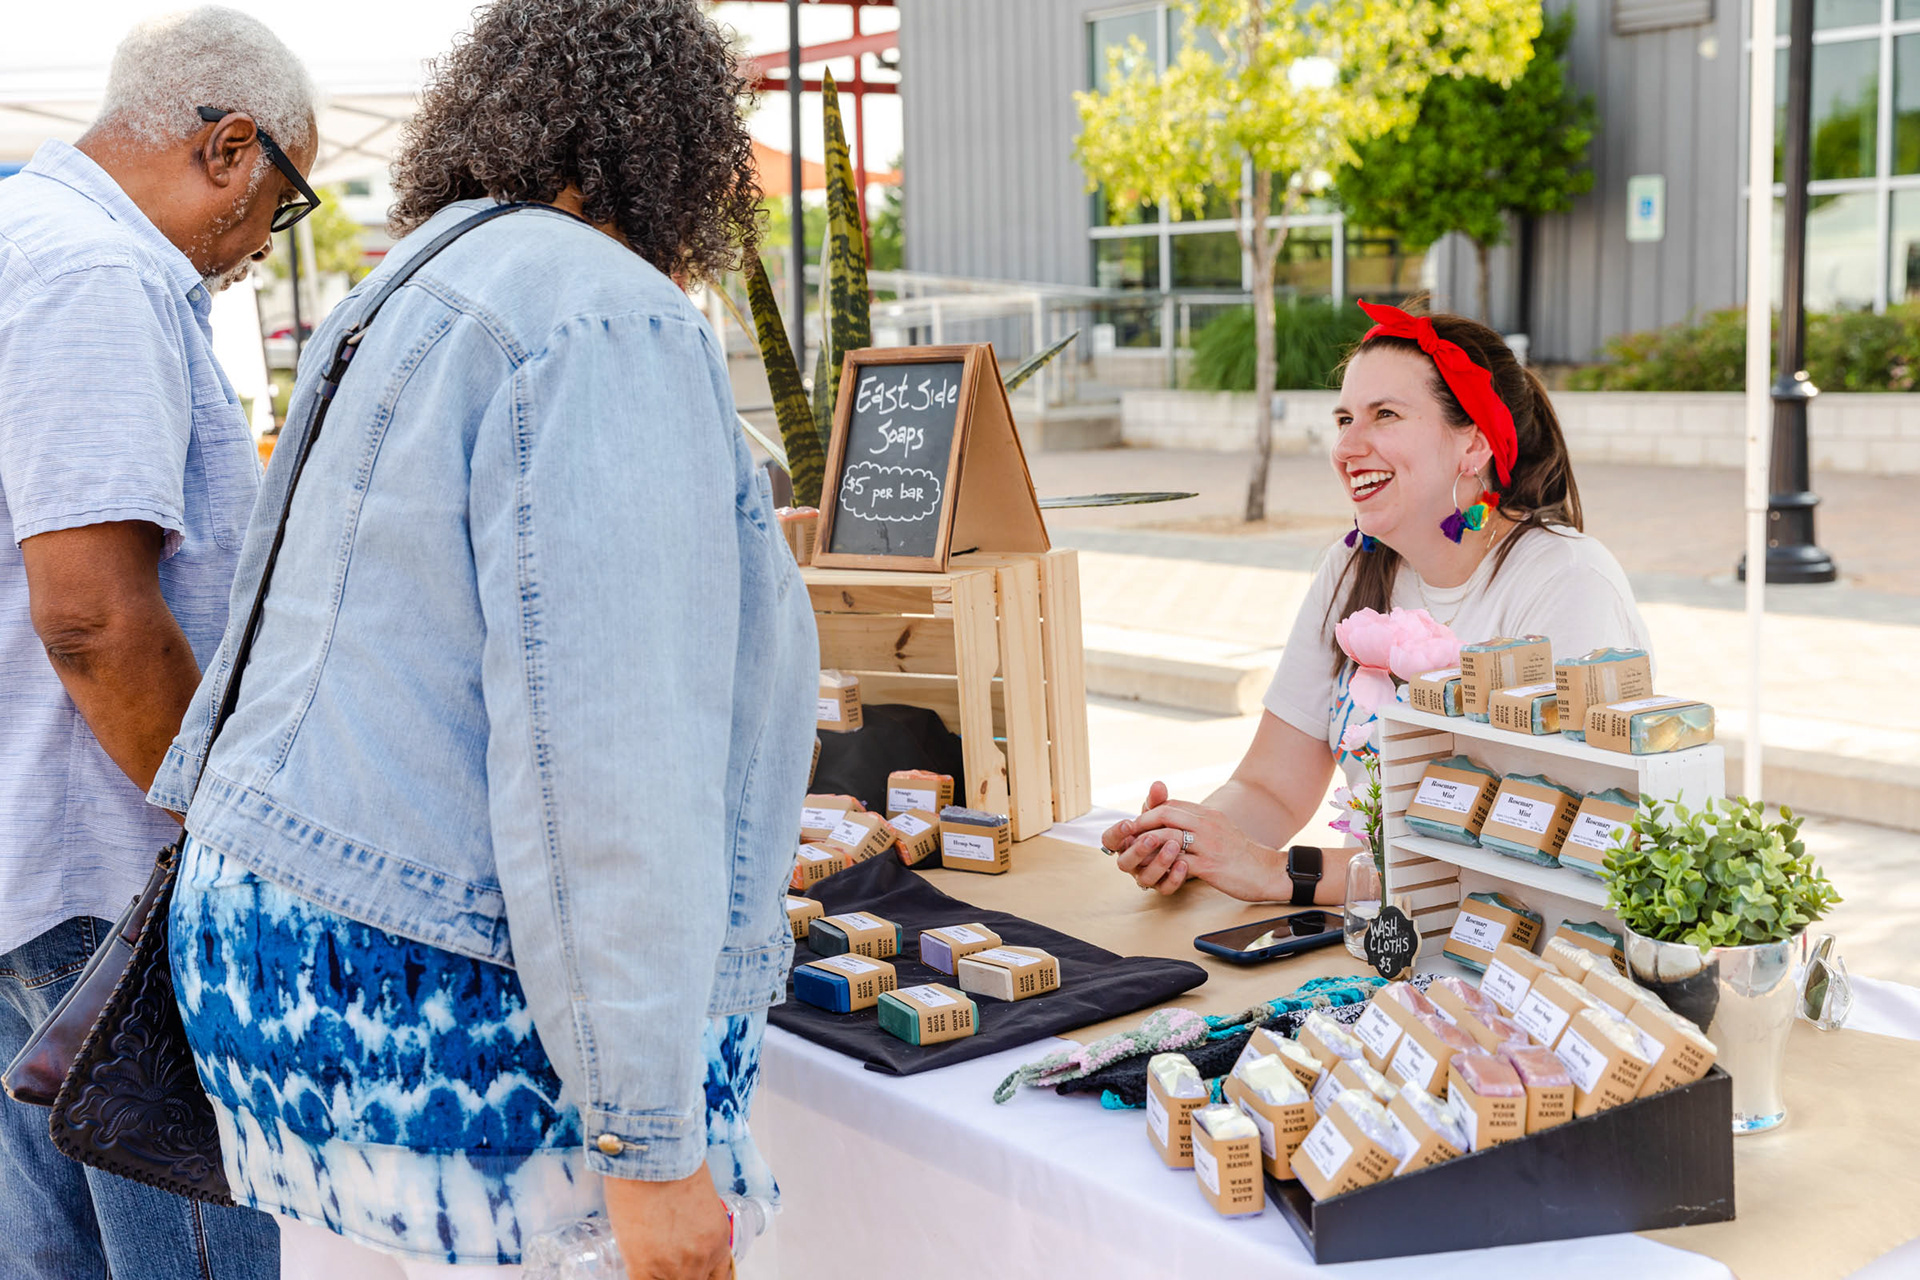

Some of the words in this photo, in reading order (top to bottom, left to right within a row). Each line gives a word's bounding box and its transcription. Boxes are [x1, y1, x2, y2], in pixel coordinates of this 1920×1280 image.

[856, 373, 908, 414] East
[911, 379, 958, 410] Side
[870, 419, 924, 458] Soaps
[846, 476, 870, 495] $5
[1431, 780, 1457, 791] Rosemary
[1508, 797, 1533, 809] Rosemary
[1519, 809, 1531, 818] Mint
[1586, 817, 1610, 829] Rosemary
[1595, 830, 1608, 839] Mint
[1370, 916, 1397, 938] WASH
[1465, 916, 1488, 928] Rosemary
[1519, 920, 1533, 931] WASH
[1474, 928, 1485, 937] Mint
[1512, 933, 1529, 944] HANDS
[1516, 927, 1530, 938] YOUR
[1370, 937, 1409, 954] CLOTHS
[1379, 956, 1391, 973] $3
[1685, 1044, 1704, 1060] WASH
[1622, 1058, 1642, 1072] WASH
[1680, 1053, 1699, 1067] YOUR
[1618, 1067, 1638, 1080] YOUR
[1672, 1059, 1696, 1076] HANDS
[1295, 1069, 1313, 1081] WASH
[1611, 1073, 1635, 1089] HANDS
[1365, 1156, 1382, 1171] YOUR
[1370, 1149, 1388, 1164] WASH
[1357, 1162, 1379, 1181] HANDS
